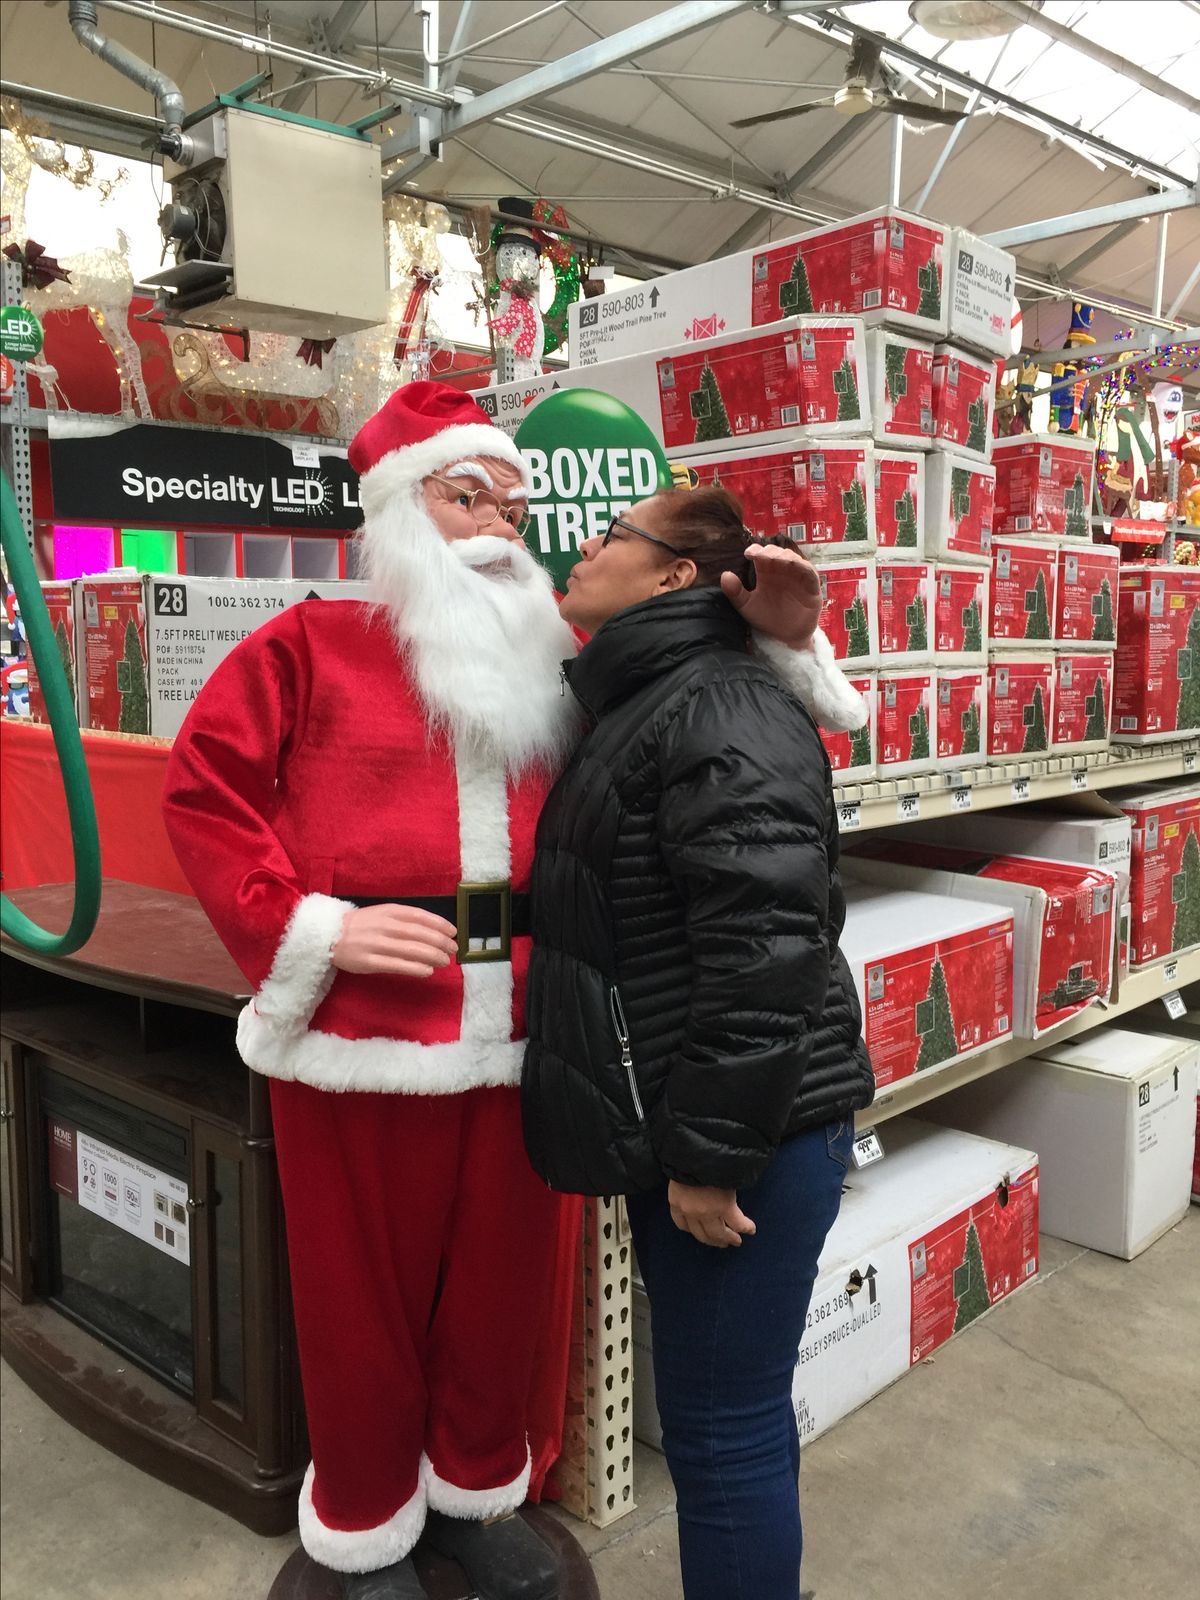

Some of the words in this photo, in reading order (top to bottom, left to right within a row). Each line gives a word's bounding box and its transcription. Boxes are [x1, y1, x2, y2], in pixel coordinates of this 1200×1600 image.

[961, 255, 971, 270] 28
[583, 307, 595, 324] 28
[602, 293, 644, 318] 590-803
[609, 321, 624, 334] Wood
[639, 314, 652, 325] Pine
[653, 311, 666, 320] Tree
[580, 350, 596, 359] CHINA
[521, 448, 658, 499] BOXED
[122, 468, 264, 508] Specialty
[271, 478, 324, 505] LED
[528, 501, 632, 554] TRE
[158, 587, 184, 613] 28
[208, 596, 236, 608] 1002
[240, 596, 262, 608] 362
[265, 598, 285, 608] 374
[156, 630, 180, 640] 7.5FT
[182, 630, 215, 641] PRELIT
[158, 690, 182, 700] TREE
[54, 1126, 72, 1143] HOME
[104, 1172, 118, 1186] 1000
[815, 1303, 832, 1323] 362
[833, 1291, 849, 1312] 369
[796, 1339, 822, 1367] ESLEY
